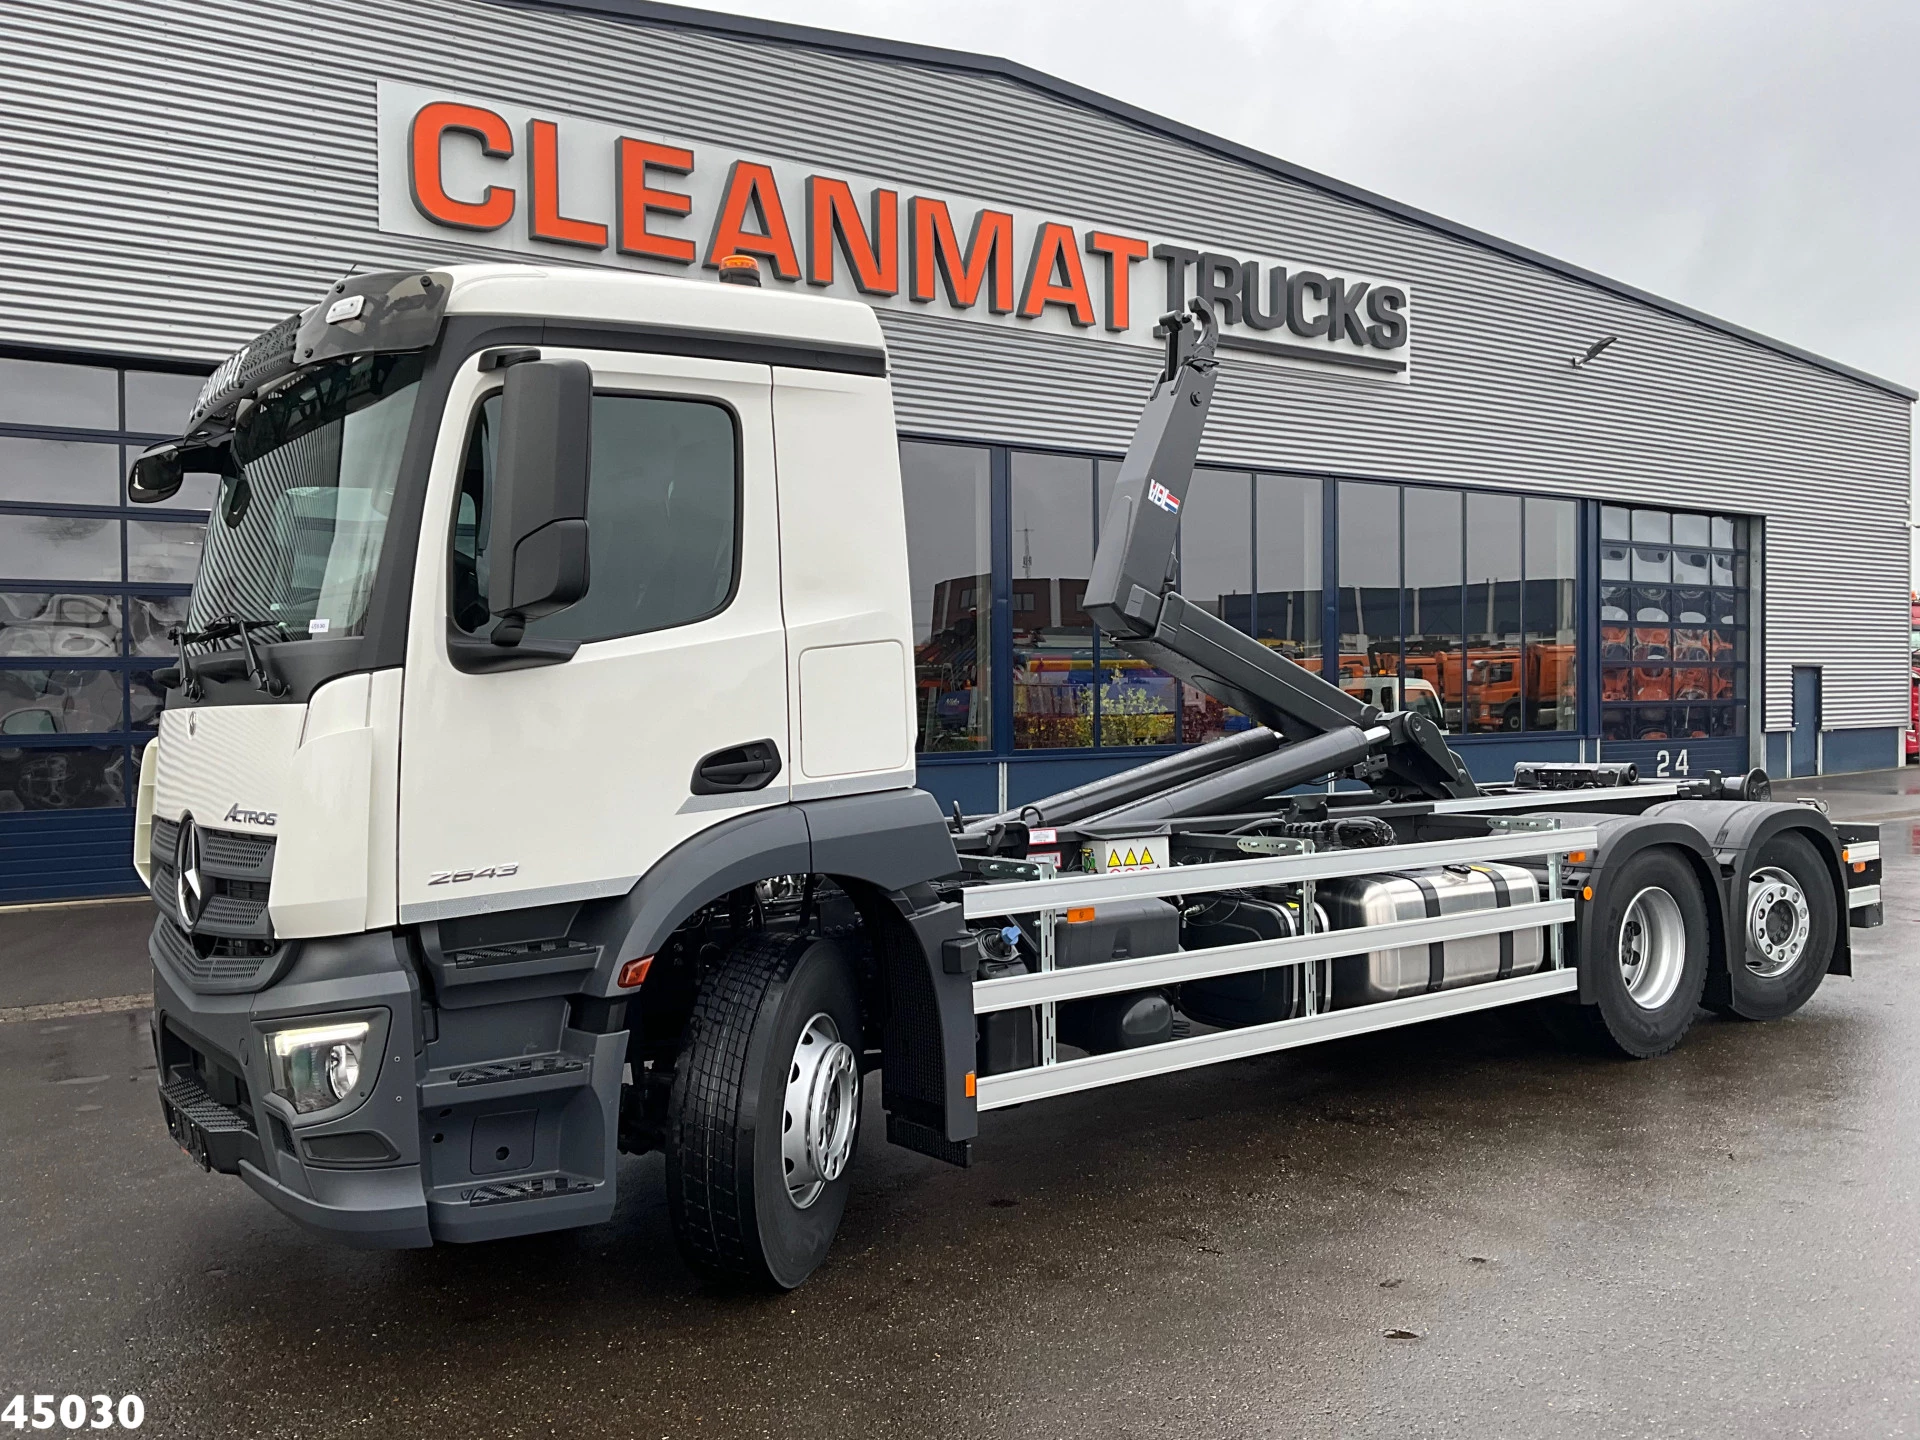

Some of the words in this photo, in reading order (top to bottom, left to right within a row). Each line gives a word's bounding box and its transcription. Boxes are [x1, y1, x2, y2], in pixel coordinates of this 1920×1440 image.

[407, 101, 1149, 334] CLEANMAT
[1153, 243, 1408, 350] TRUCKS
[1656, 749, 1689, 777] 24
[428, 862, 519, 886] 2643
